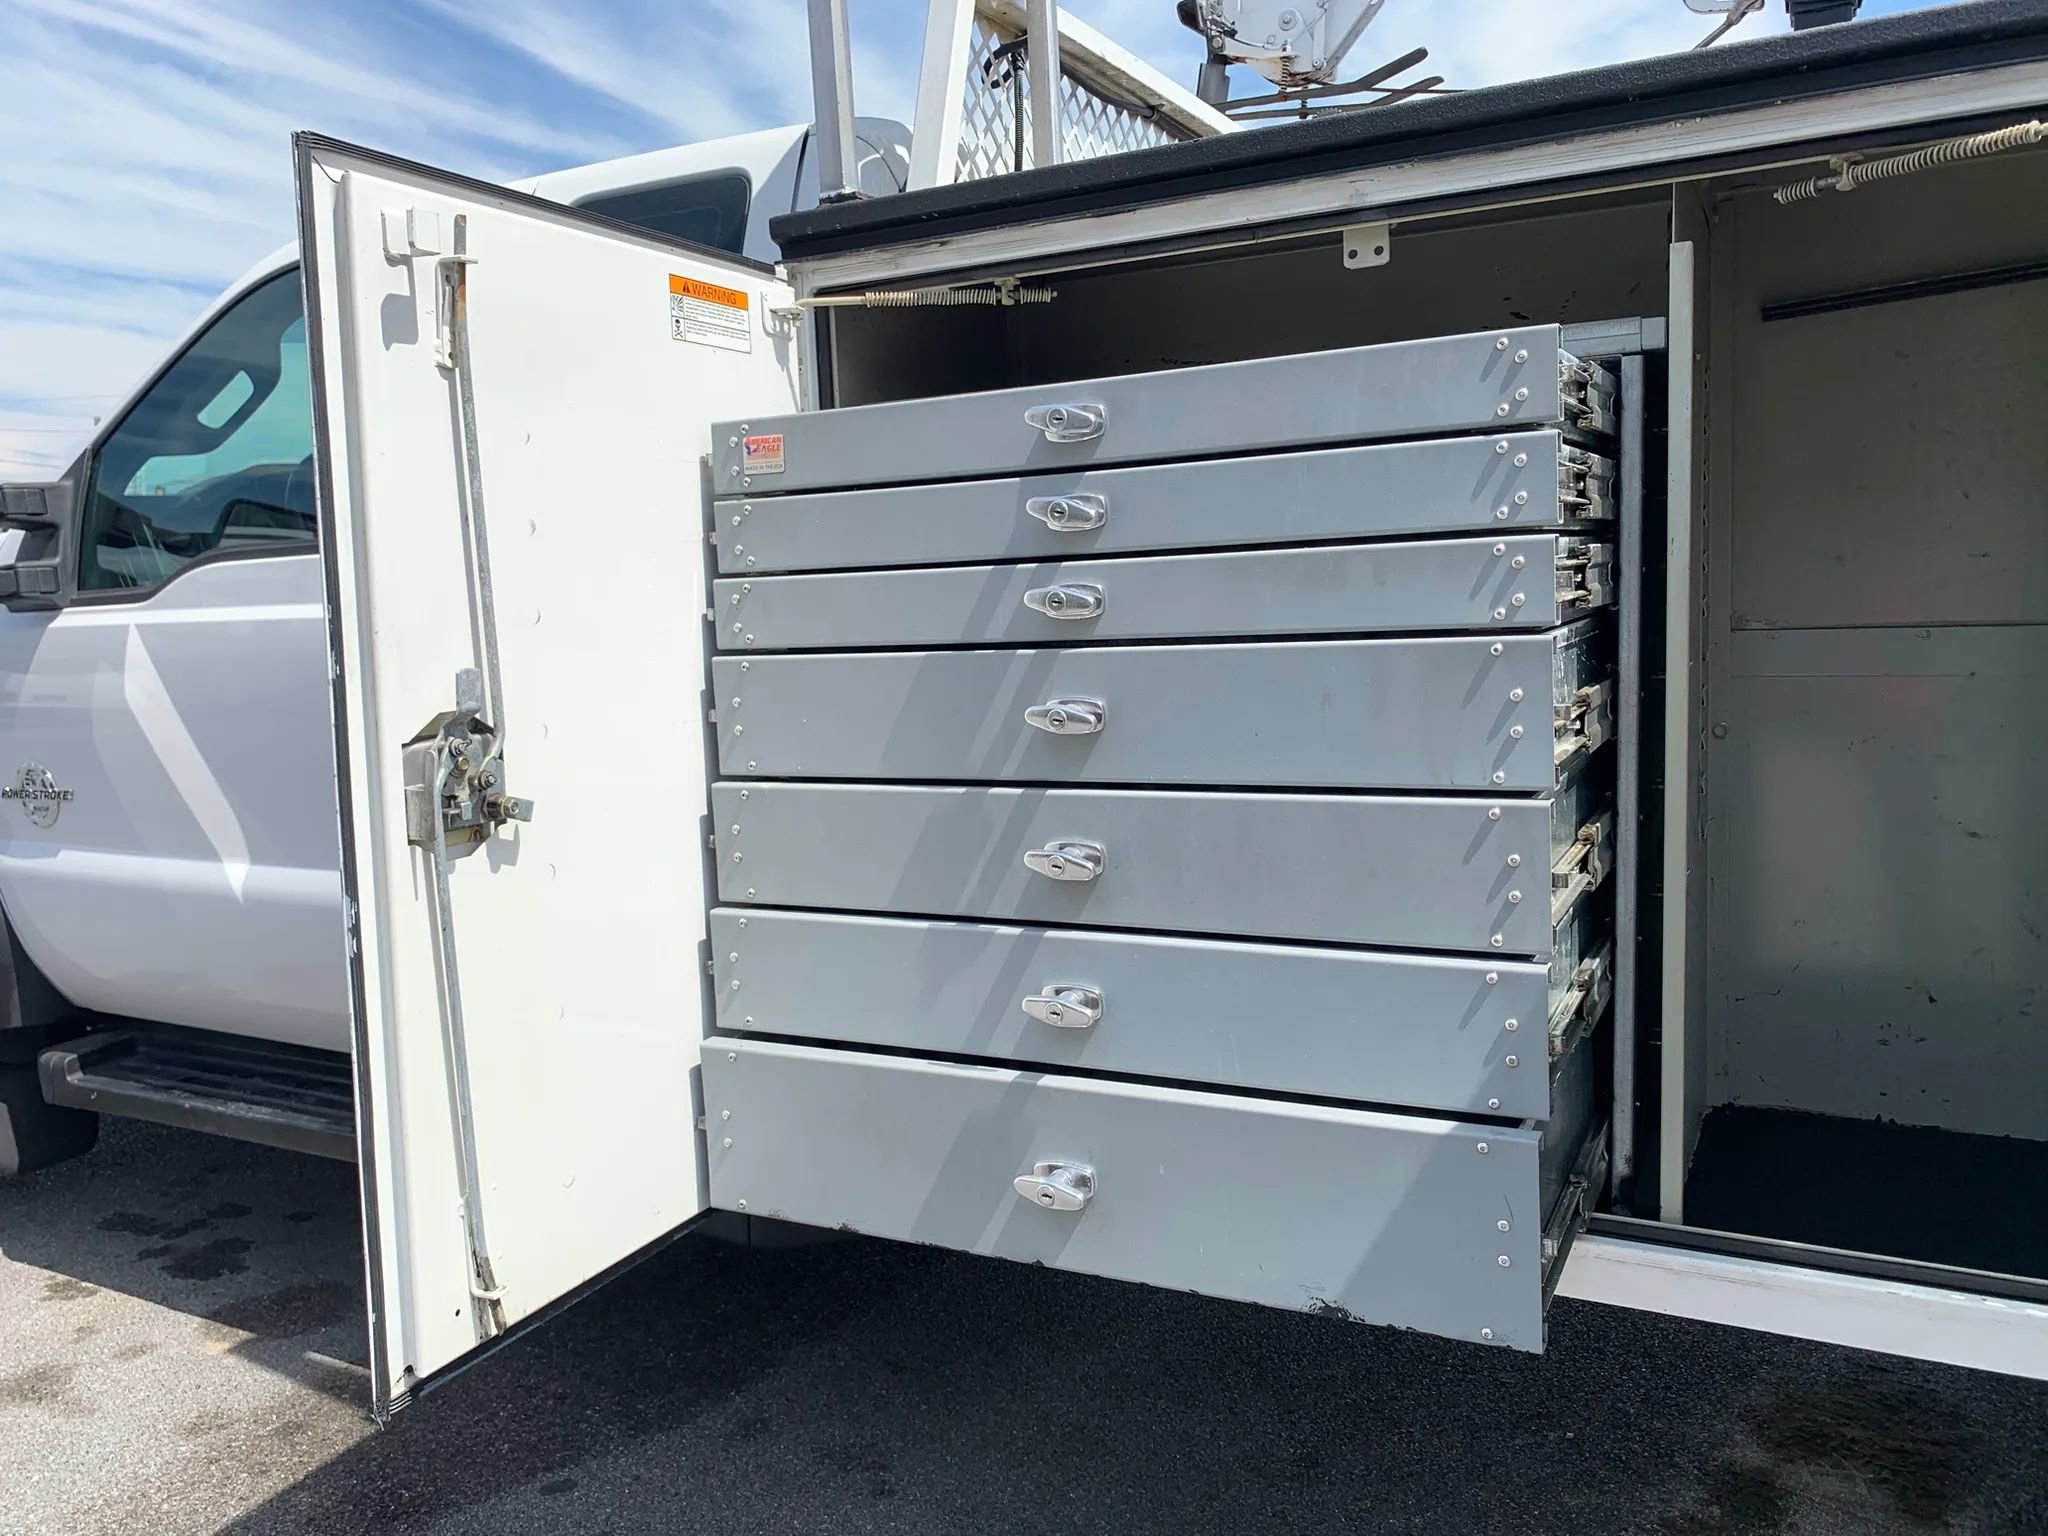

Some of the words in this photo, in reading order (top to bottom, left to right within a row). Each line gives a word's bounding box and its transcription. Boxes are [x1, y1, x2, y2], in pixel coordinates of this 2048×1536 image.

[692, 283, 737, 305] WARNING
[746, 436, 782, 445] AMERICAN
[756, 444, 781, 452] EAGLE
